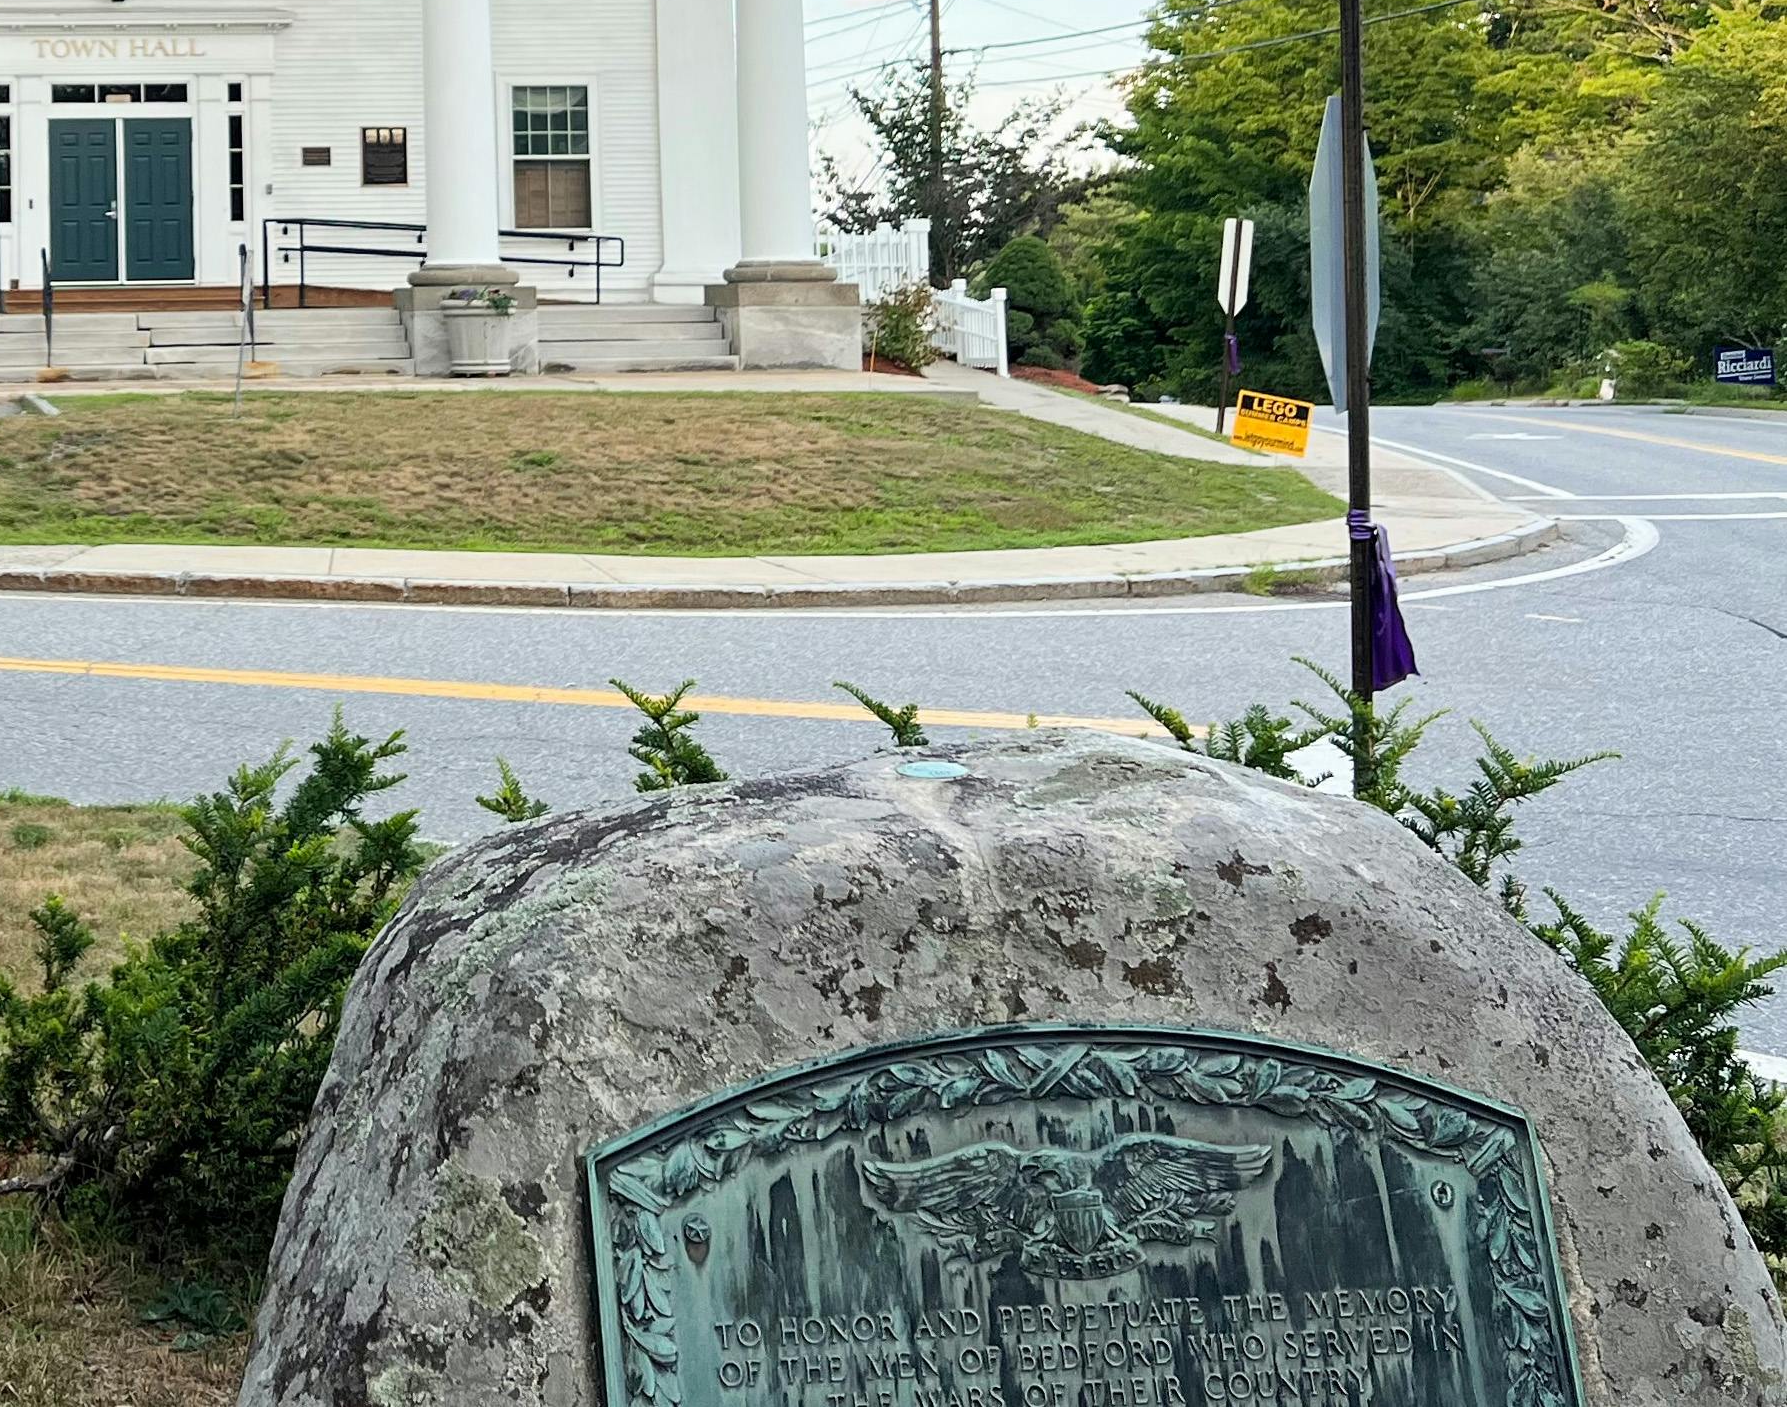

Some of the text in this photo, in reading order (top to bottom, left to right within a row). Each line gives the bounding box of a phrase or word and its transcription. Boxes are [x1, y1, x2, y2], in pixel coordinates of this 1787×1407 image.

[32, 37, 206, 59] TOWN HALL
[1717, 356, 1772, 374] Ricciardi
[1253, 398, 1297, 417] LEGO
[714, 1285, 1458, 1350] TO HONOR AND PERPETUATE THE MEMORY
[718, 1323, 1462, 1388] OF THE MEN OF BEDFORD WHO SERVED IN
[914, 1385, 1006, 1407] WARS
[1023, 1381, 1067, 1407] OF
[1083, 1374, 1186, 1407] THEIR
[1204, 1365, 1369, 1401] COUNTRY
